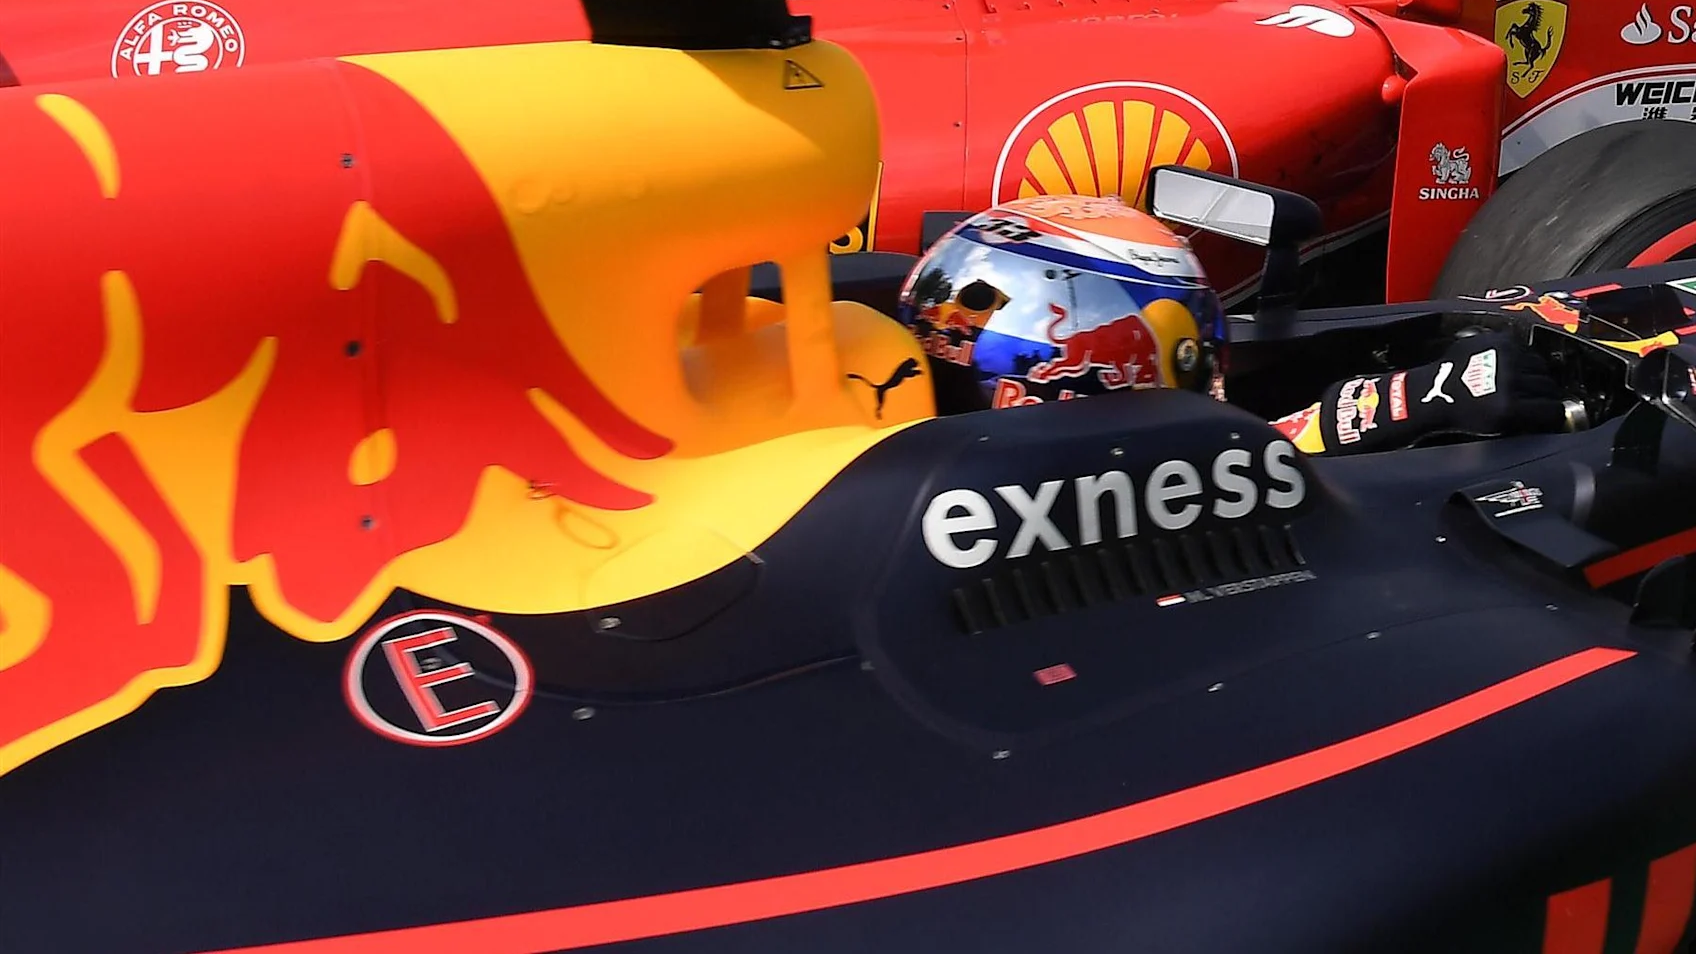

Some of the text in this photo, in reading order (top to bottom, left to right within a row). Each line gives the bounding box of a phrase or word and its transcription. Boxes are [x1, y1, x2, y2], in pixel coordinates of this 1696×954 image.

[120, 3, 239, 60] ALFA ROMEO
[1419, 187, 1479, 199] SINGHA
[922, 439, 1306, 568] exness
[381, 626, 501, 733] E
